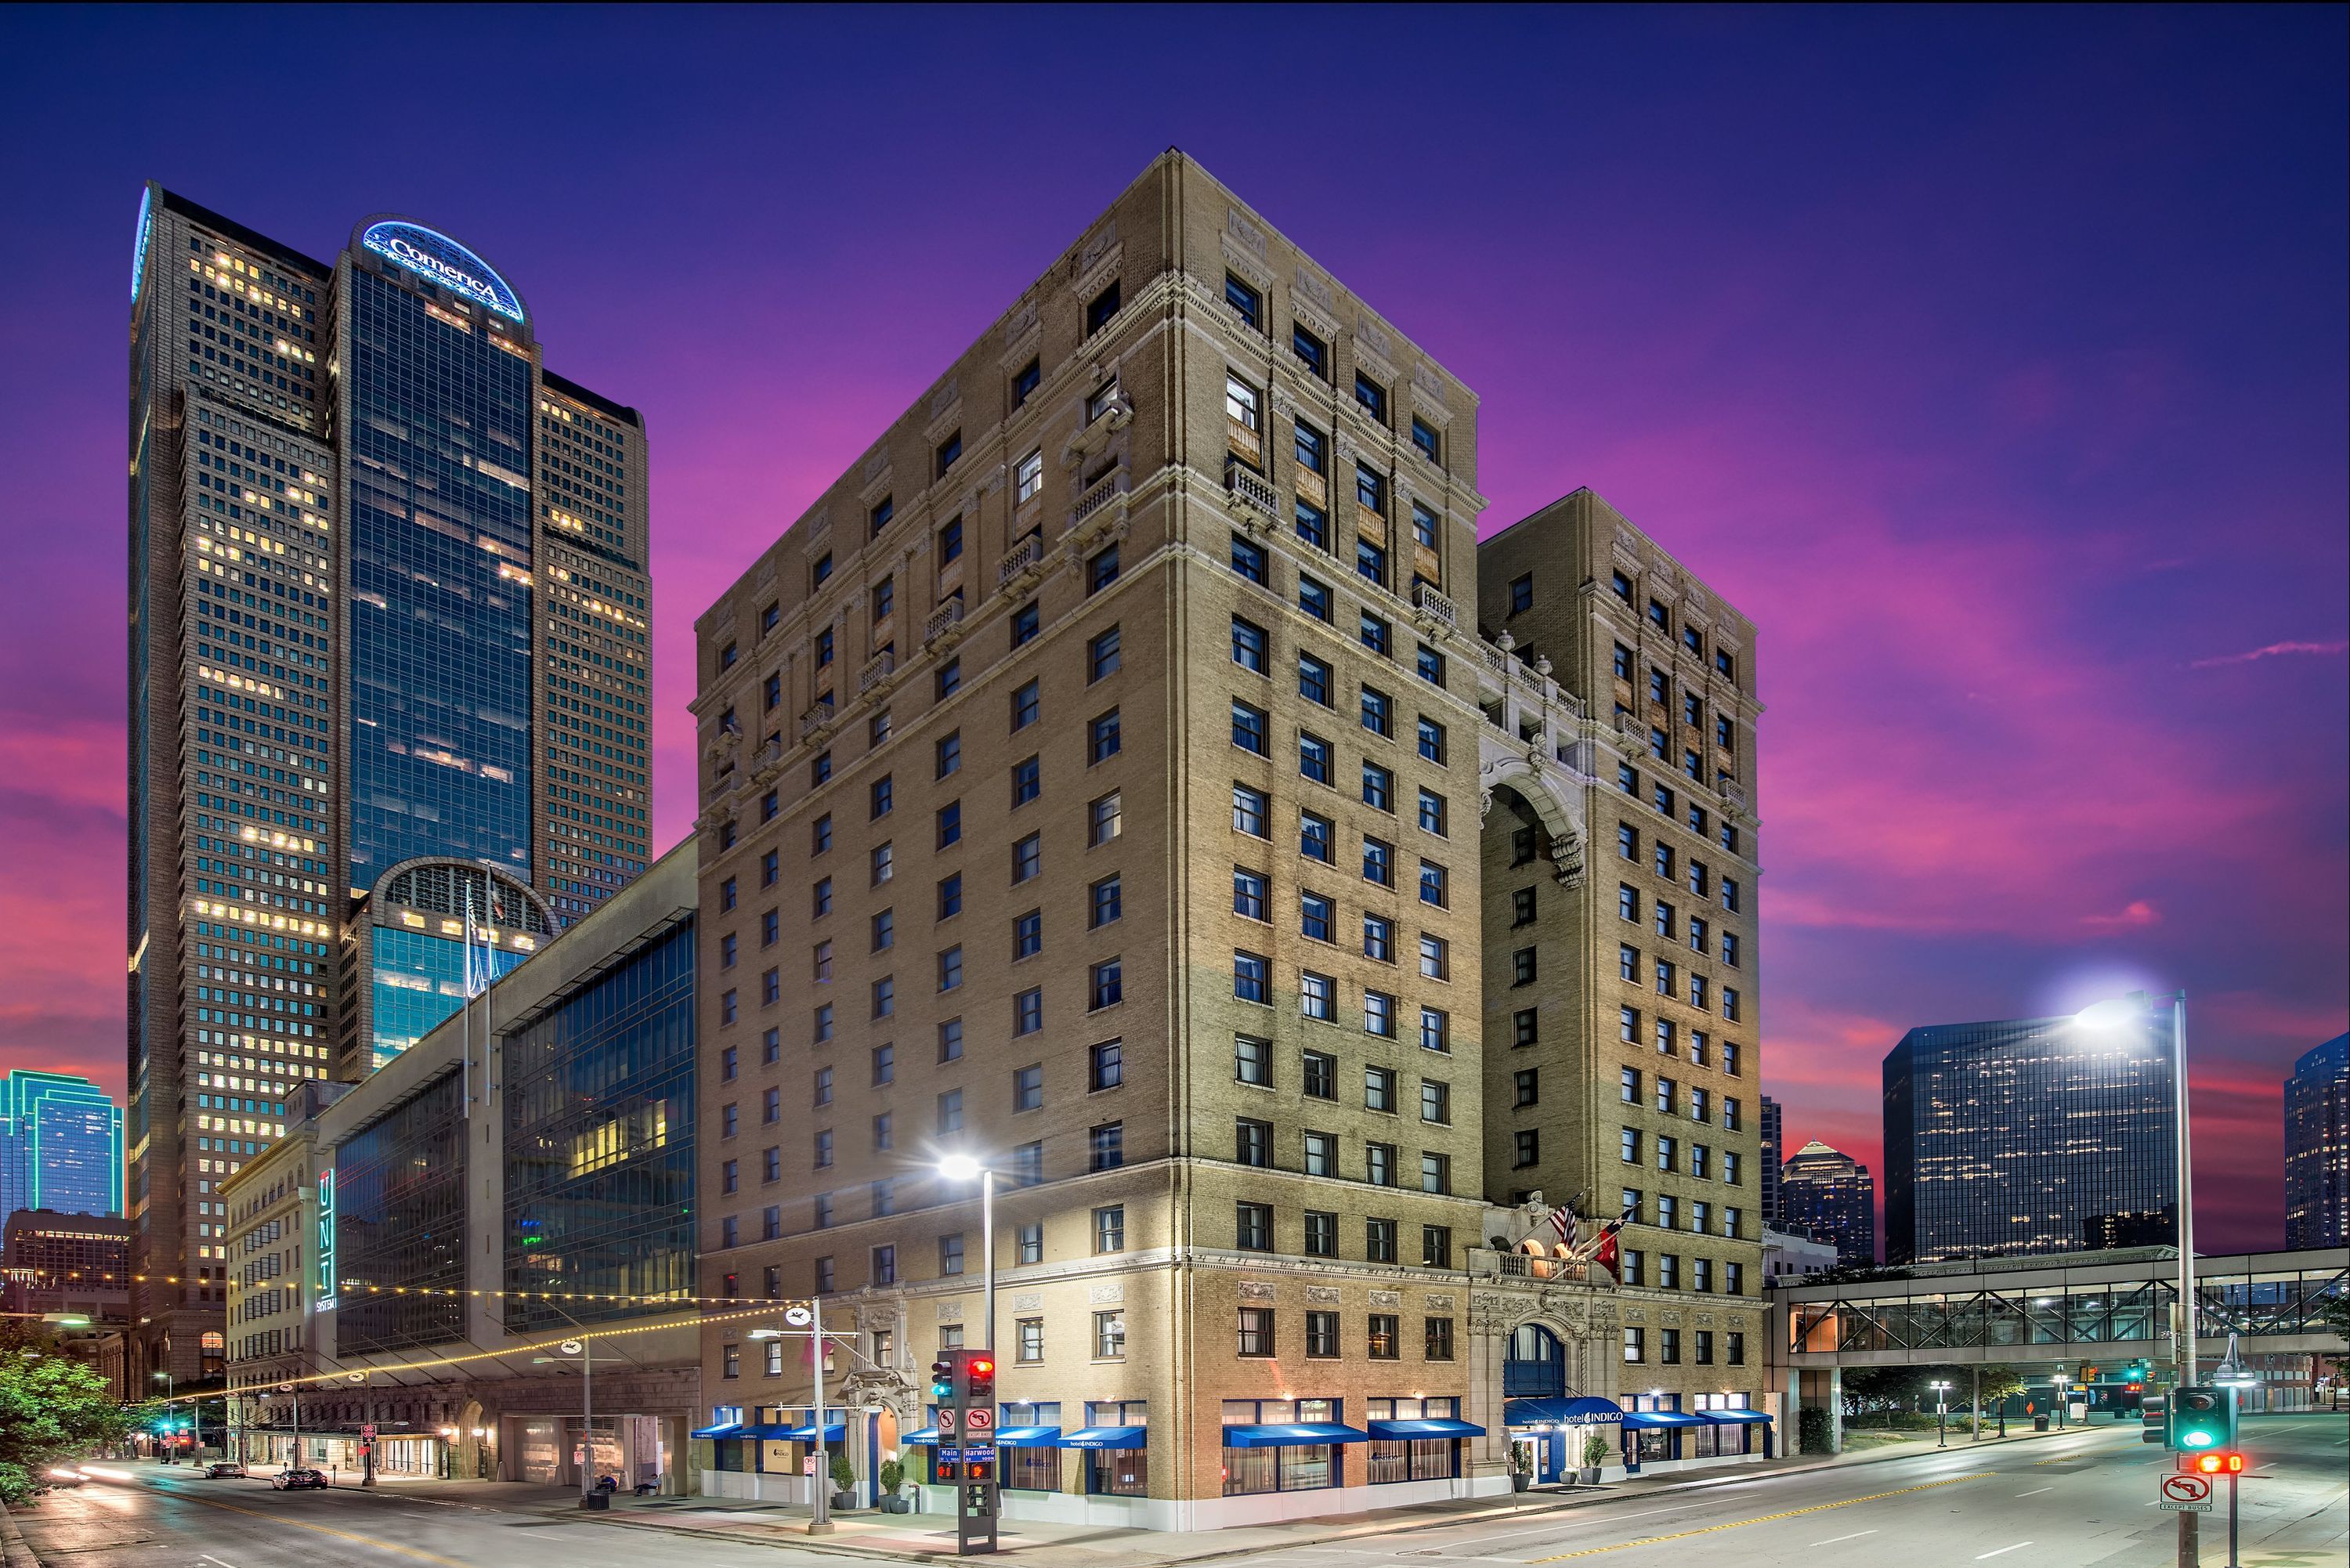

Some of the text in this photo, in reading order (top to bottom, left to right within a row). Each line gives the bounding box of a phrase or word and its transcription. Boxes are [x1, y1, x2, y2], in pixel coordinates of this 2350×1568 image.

[320, 1176, 330, 1290] UNT
[1564, 1412, 1623, 1423] hotel INDIGO
[2229, 1456, 2241, 1471] 0
